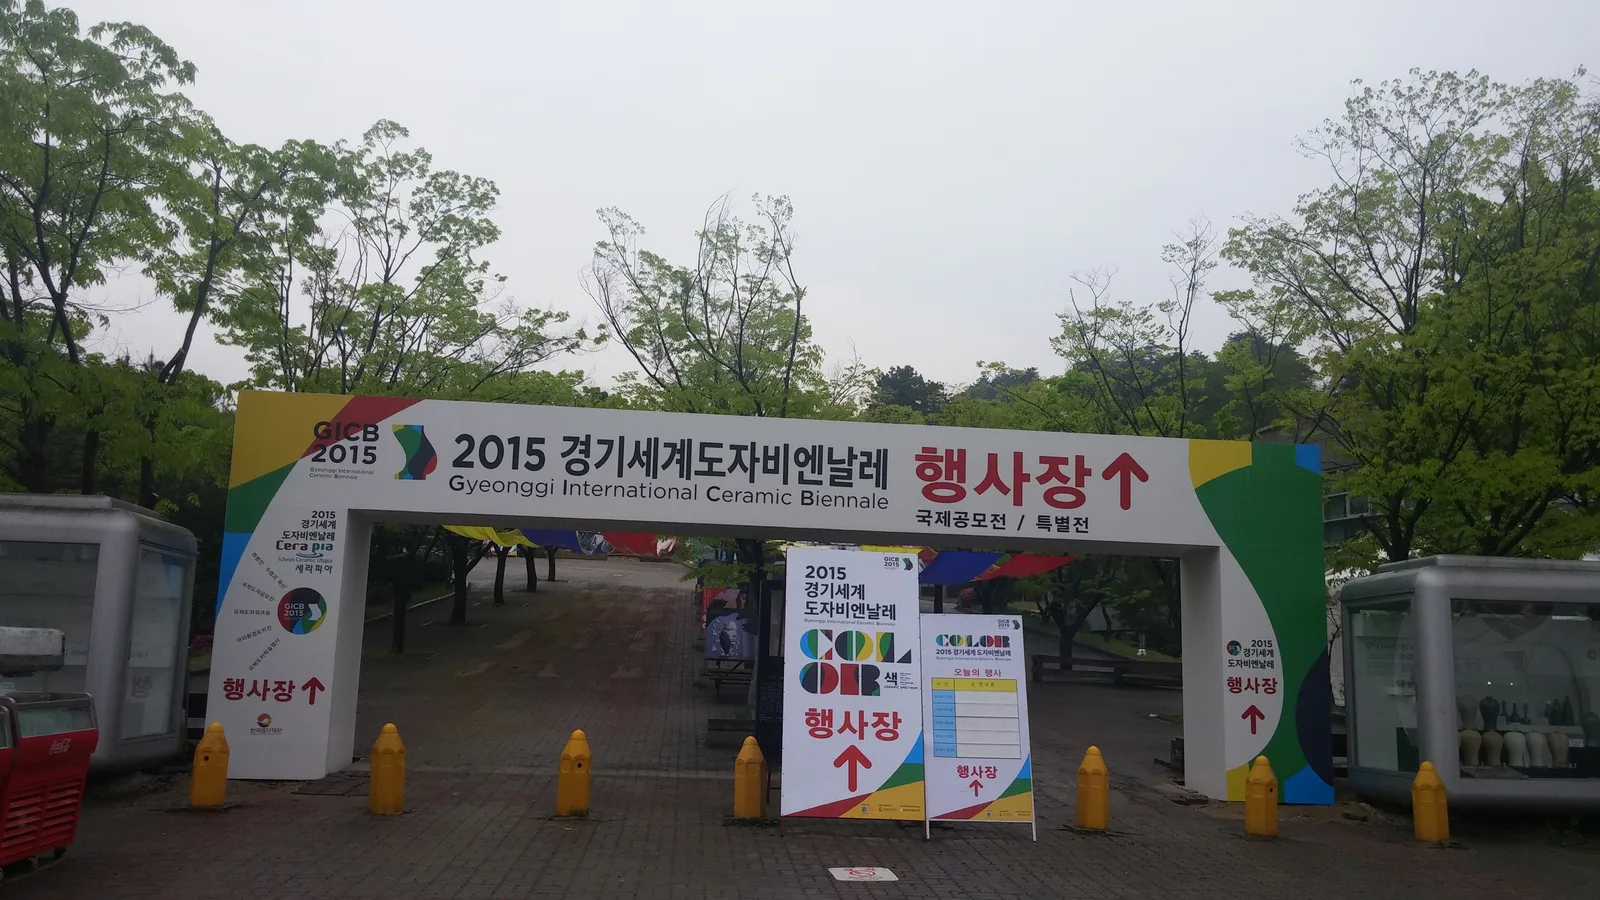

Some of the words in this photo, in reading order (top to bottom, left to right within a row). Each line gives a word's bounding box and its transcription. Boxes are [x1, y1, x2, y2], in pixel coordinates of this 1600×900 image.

[313, 420, 379, 442] GICB
[311, 443, 377, 465] 2015
[452, 433, 546, 472] 2015
[560, 434, 889, 491] 경기세계도자비엔날레
[914, 446, 1092, 511] 행사장
[449, 474, 555, 498] Gyeonggi
[562, 479, 698, 501] International
[706, 485, 793, 506] Ceramic
[800, 489, 889, 510] Biennale
[311, 510, 336, 519] 2015
[915, 509, 1007, 531] 국제공모전
[1035, 515, 1090, 534] 특별전
[301, 519, 337, 530] 경기세계
[281, 530, 336, 542] 도자비엔날레
[275, 540, 309, 551] Cera
[311, 542, 334, 553] pia
[294, 564, 333, 575] 세라피아
[804, 565, 847, 581] 2015
[804, 581, 866, 601] 경기세계
[283, 609, 304, 617] 2015
[284, 602, 305, 610] GICB
[803, 600, 897, 621] 도자비엔날레
[1251, 640, 1273, 648] 2015
[1243, 648, 1275, 658] 경기세계
[1228, 659, 1275, 670] 도자비엔날레
[884, 671, 898, 686] 색
[954, 668, 980, 677] 오늘의
[984, 668, 1002, 677] 행사
[222, 677, 296, 702] 행사장
[1226, 676, 1278, 695] 행사장
[804, 708, 903, 742] 행사장
[957, 765, 998, 779] 행사장
